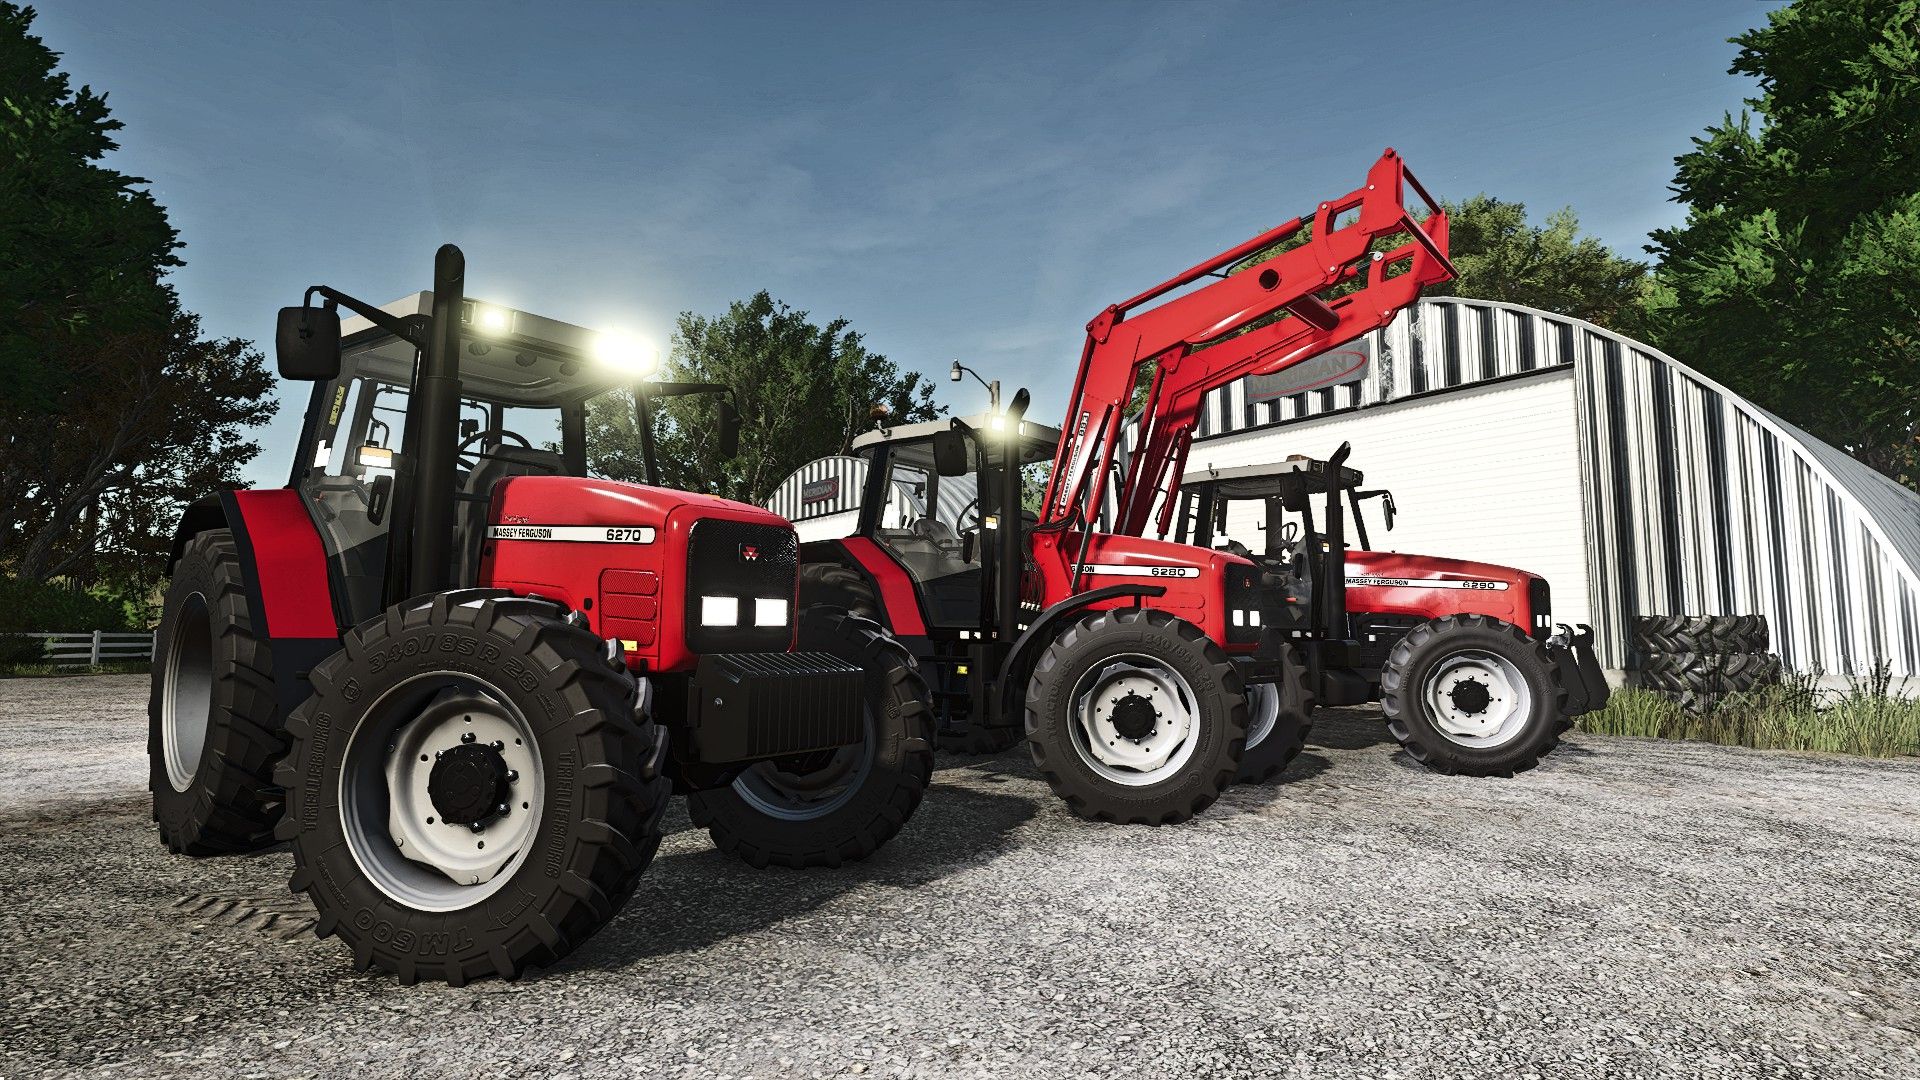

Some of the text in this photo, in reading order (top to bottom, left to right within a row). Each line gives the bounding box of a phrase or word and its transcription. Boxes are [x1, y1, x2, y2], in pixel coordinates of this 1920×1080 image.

[493, 527, 641, 541] MASSEY FERGUSON 6270
[1151, 567, 1186, 577] 6280
